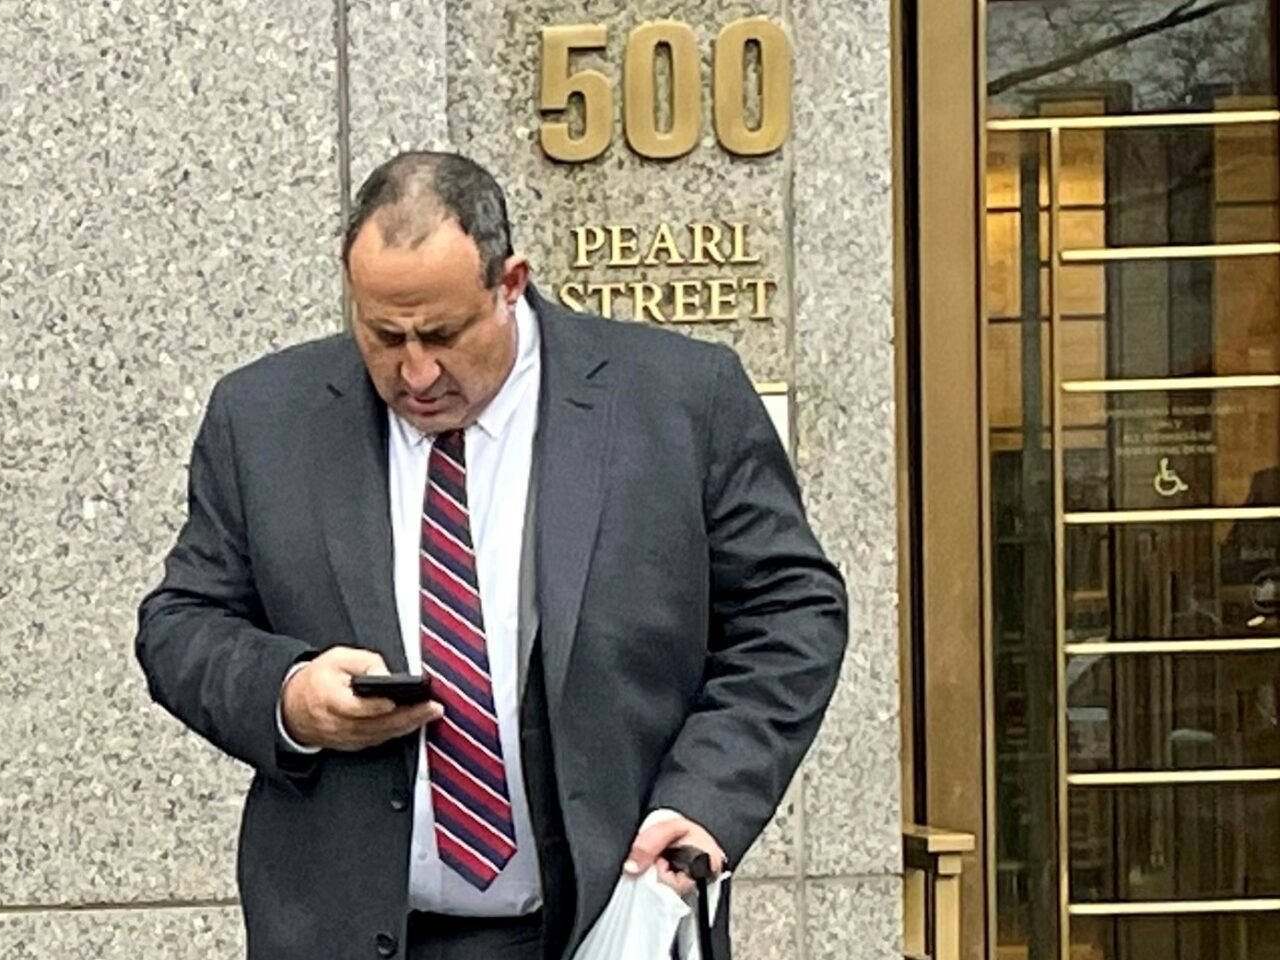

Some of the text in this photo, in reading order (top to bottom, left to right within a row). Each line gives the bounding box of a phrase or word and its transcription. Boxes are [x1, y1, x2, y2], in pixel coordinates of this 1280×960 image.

[539, 16, 792, 162] 500
[572, 222, 760, 268] PEARL
[558, 277, 777, 322] STREET
